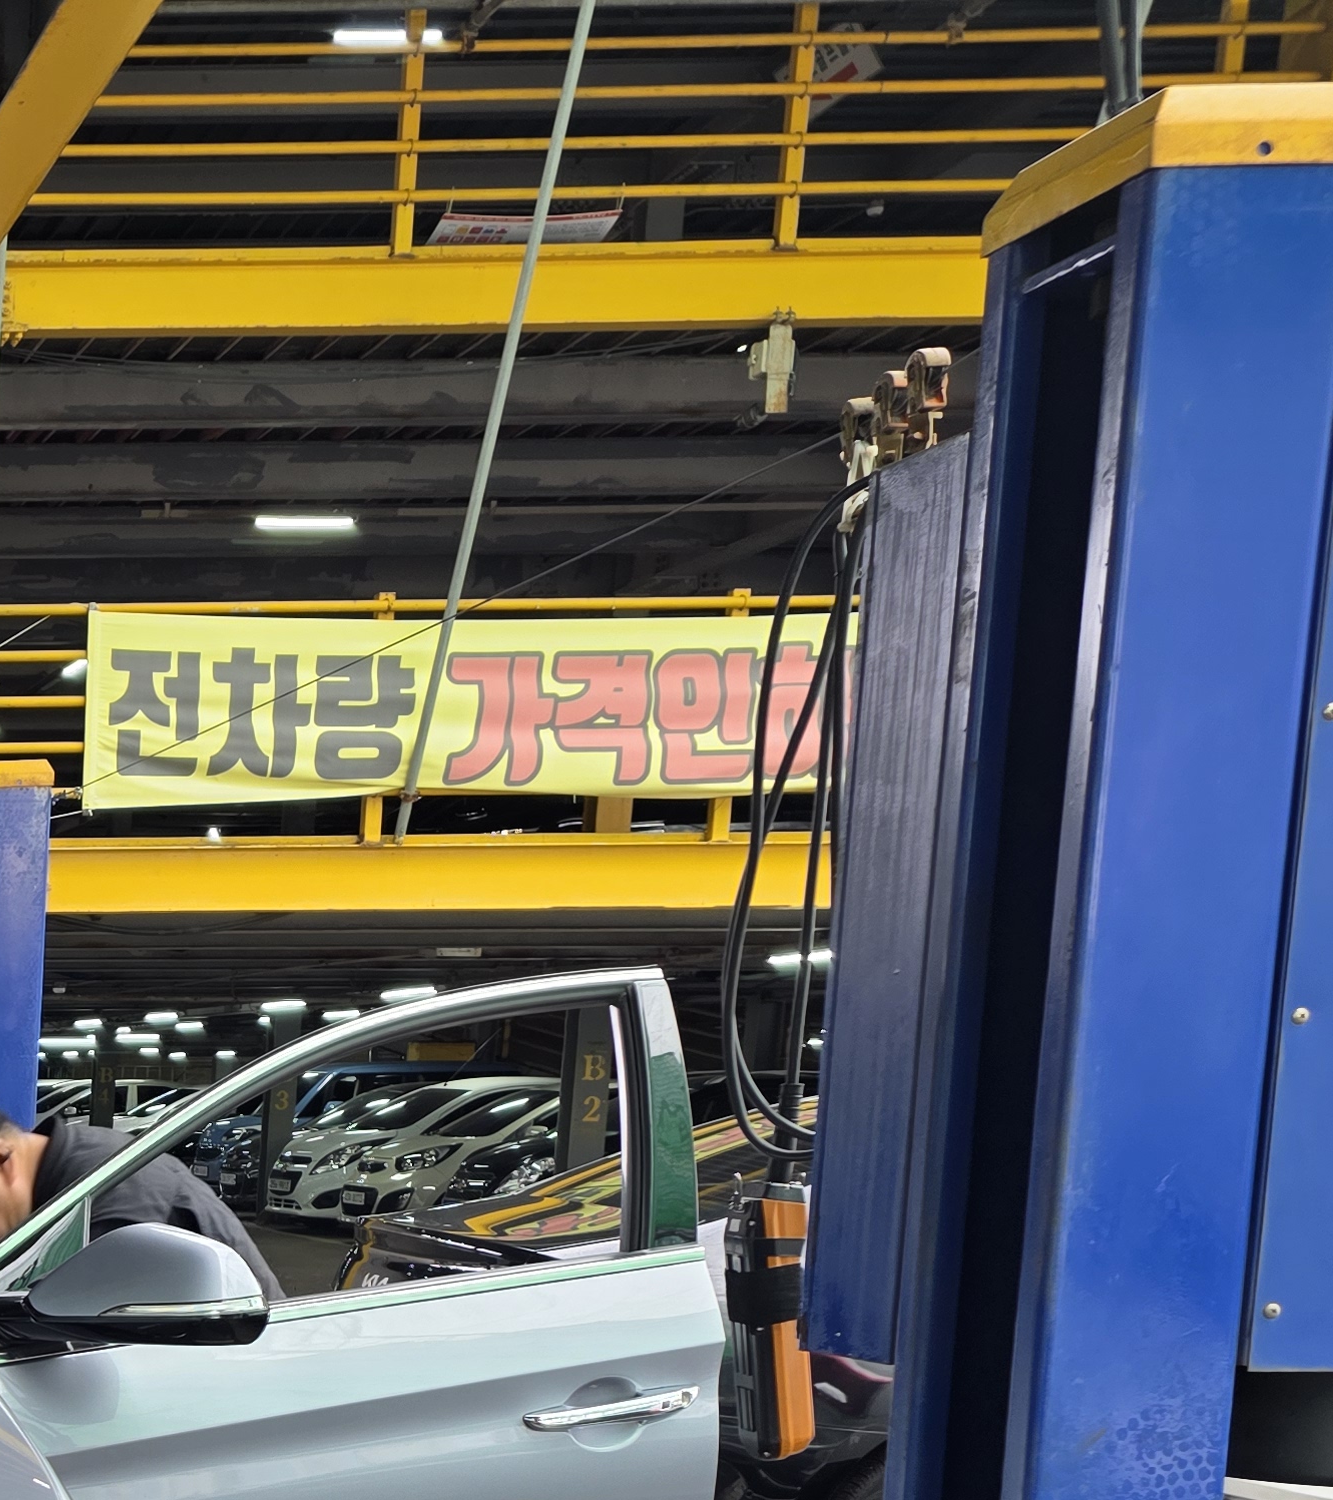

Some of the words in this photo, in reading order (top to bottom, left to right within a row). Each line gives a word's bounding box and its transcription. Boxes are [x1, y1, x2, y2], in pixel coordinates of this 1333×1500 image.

[108, 646, 416, 781] 전차량
[581, 1054, 607, 1081] B
[274, 1089, 290, 1111] 3
[581, 1095, 601, 1122] 2
